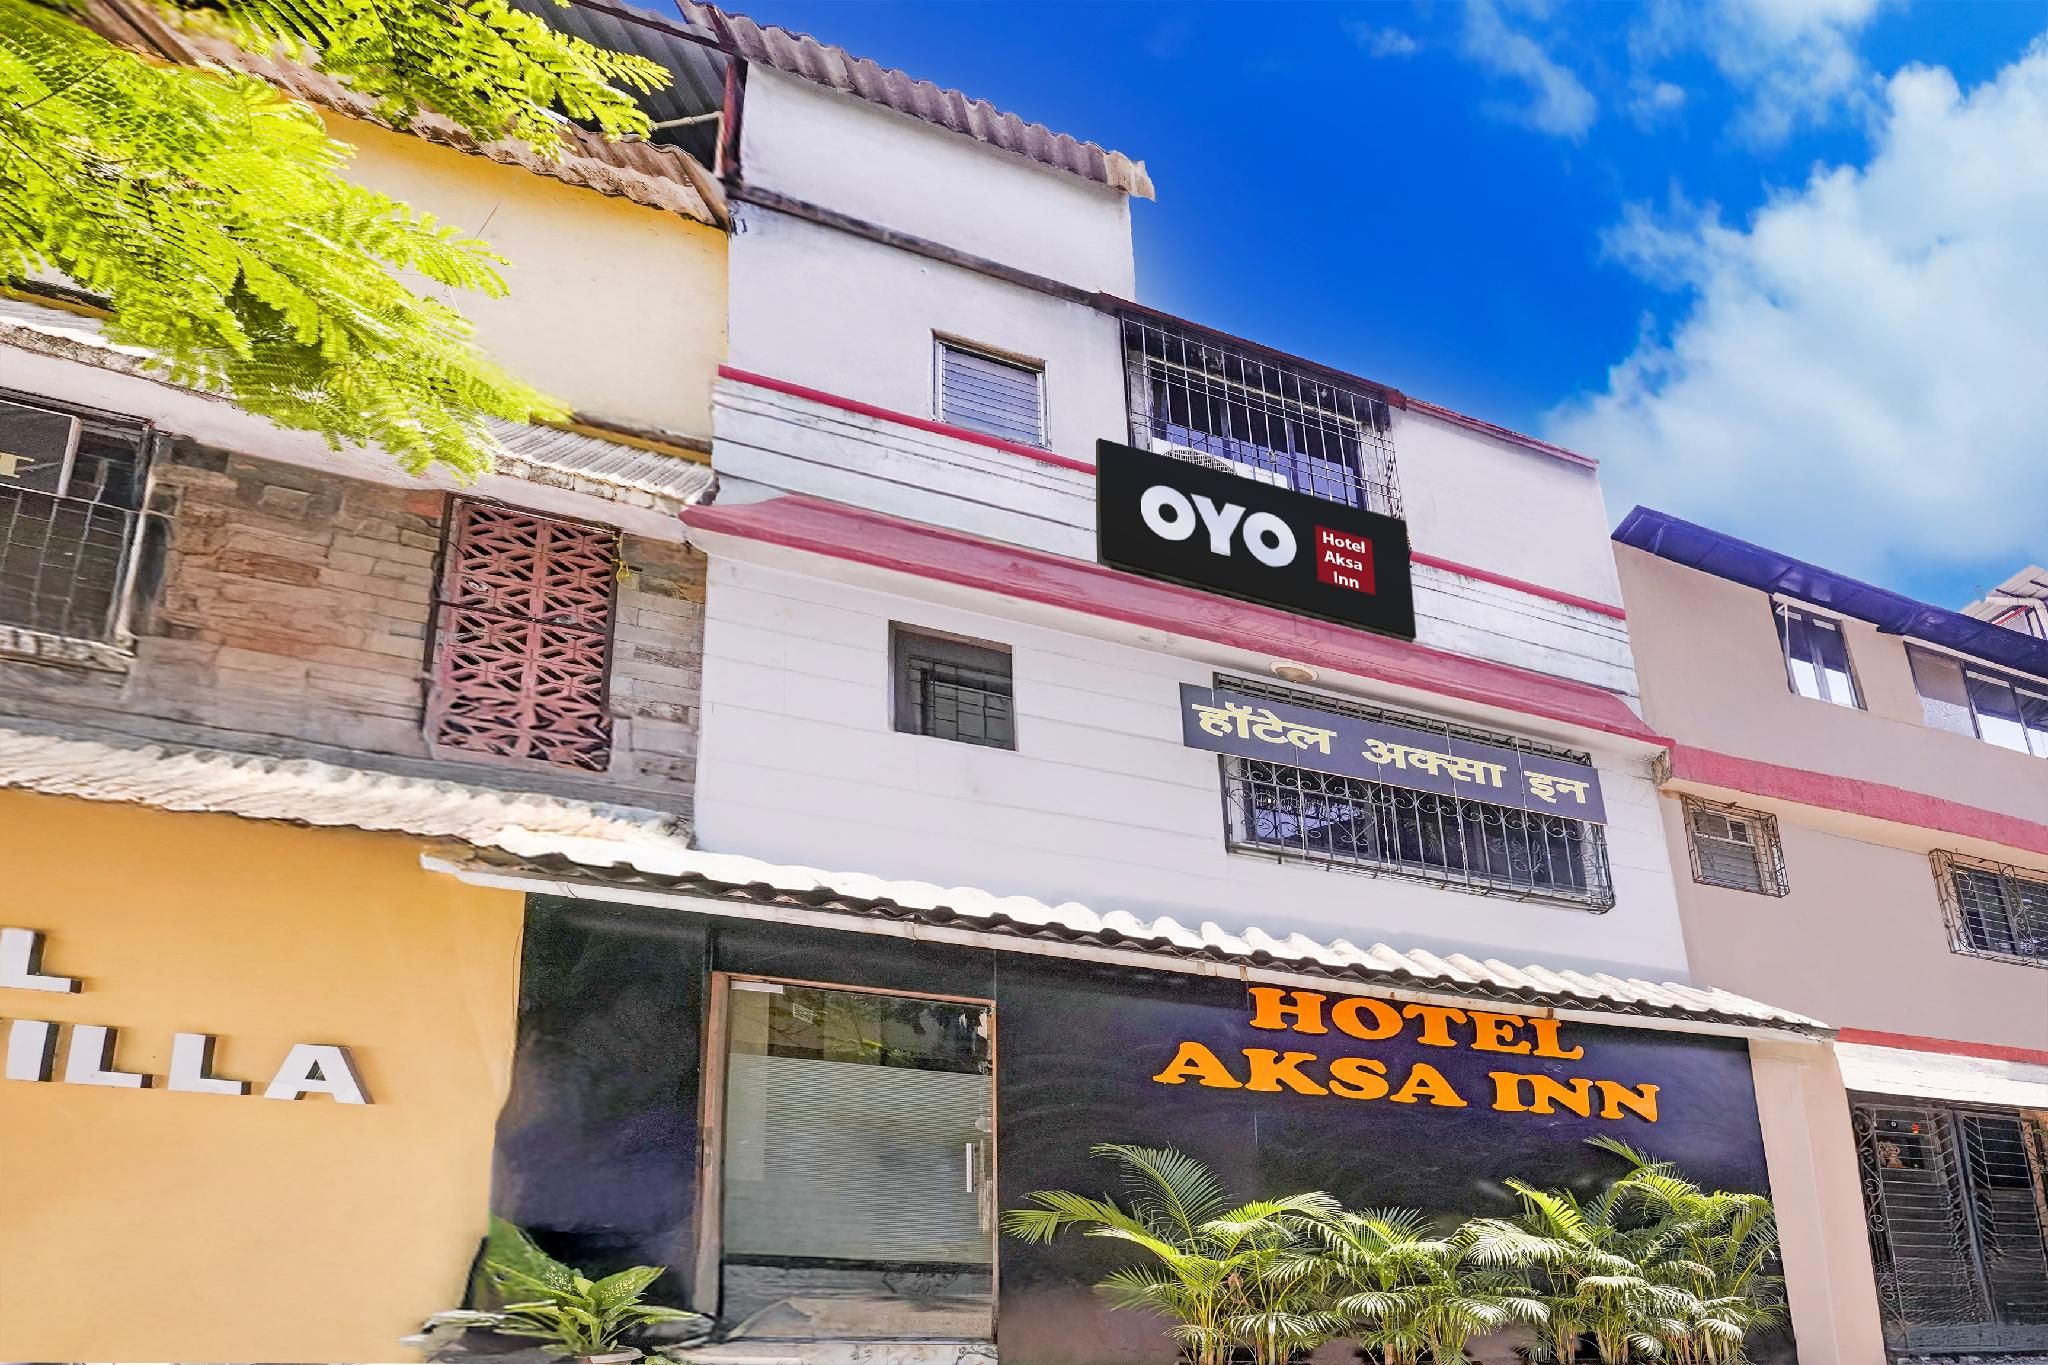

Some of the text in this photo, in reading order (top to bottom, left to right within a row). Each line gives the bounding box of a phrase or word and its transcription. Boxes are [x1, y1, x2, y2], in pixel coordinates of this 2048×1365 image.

[1140, 485, 1298, 568] OYO
[1322, 530, 1366, 554] Hotel
[1324, 550, 1363, 571] Aksa
[1333, 570, 1360, 589] Inn
[1191, 701, 1590, 805] हॉटेल अक्सा इन
[0, 1017, 374, 1106] ILLA
[1248, 986, 1585, 1061] HOTEL
[1152, 1041, 1661, 1123] AKSA INN
